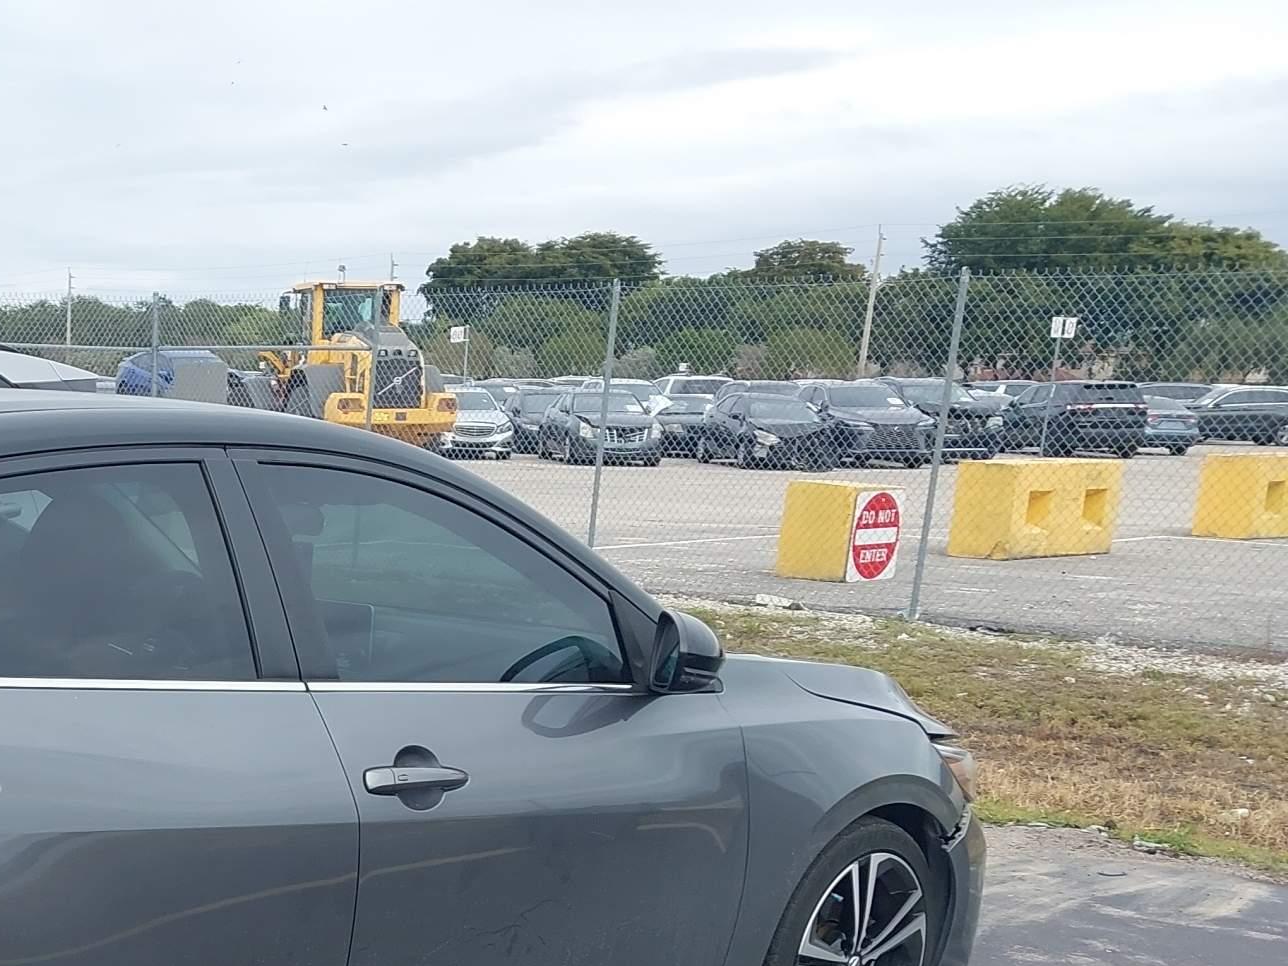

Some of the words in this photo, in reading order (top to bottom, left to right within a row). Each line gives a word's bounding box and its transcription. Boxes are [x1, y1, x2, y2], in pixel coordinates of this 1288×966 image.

[862, 510, 876, 524] DO
[878, 509, 897, 523] NOT
[859, 548, 888, 563] ENTER
